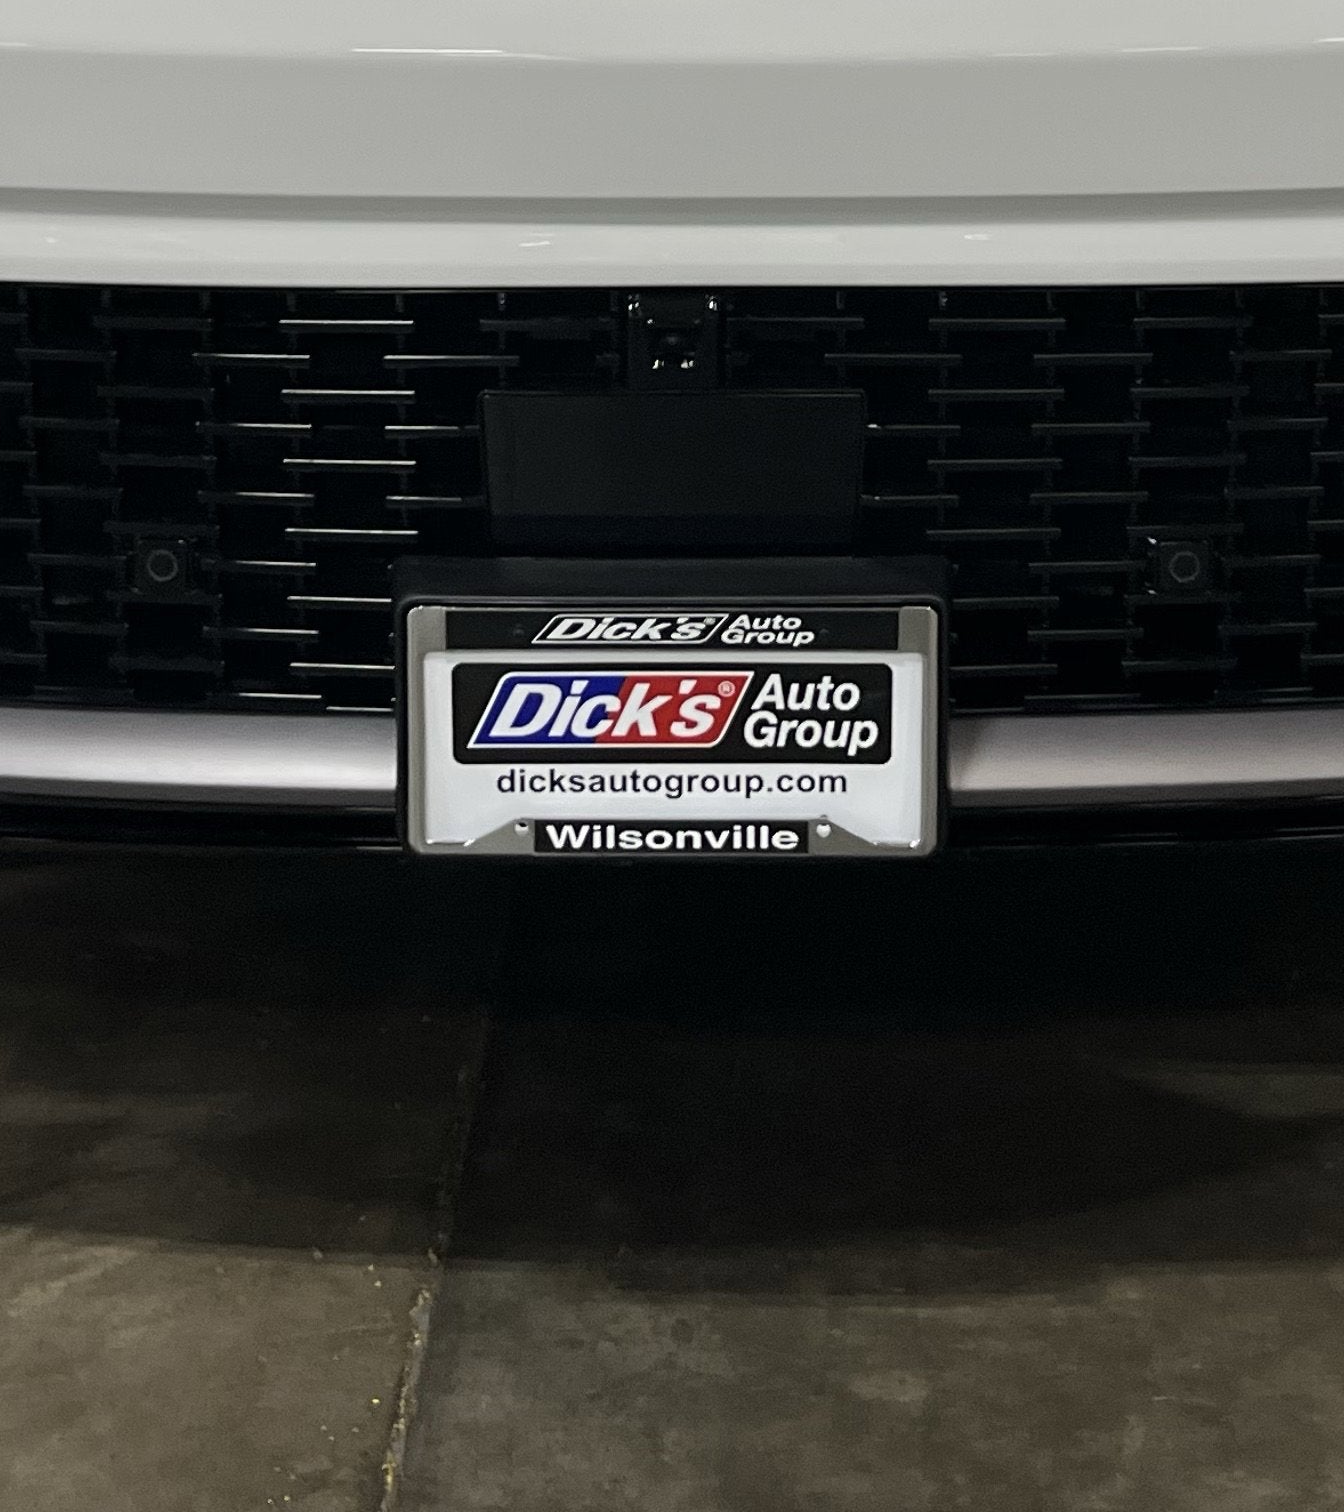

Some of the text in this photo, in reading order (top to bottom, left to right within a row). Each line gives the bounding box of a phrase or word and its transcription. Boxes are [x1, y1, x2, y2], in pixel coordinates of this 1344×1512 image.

[545, 617, 706, 640] Dick's
[729, 614, 802, 630] Auto
[720, 628, 815, 648] Group
[751, 673, 860, 712] Auto
[488, 679, 723, 738] Dick's
[743, 712, 879, 756] Group
[496, 768, 848, 800] dicksautogroup.com
[545, 821, 800, 852] Wilsonville
